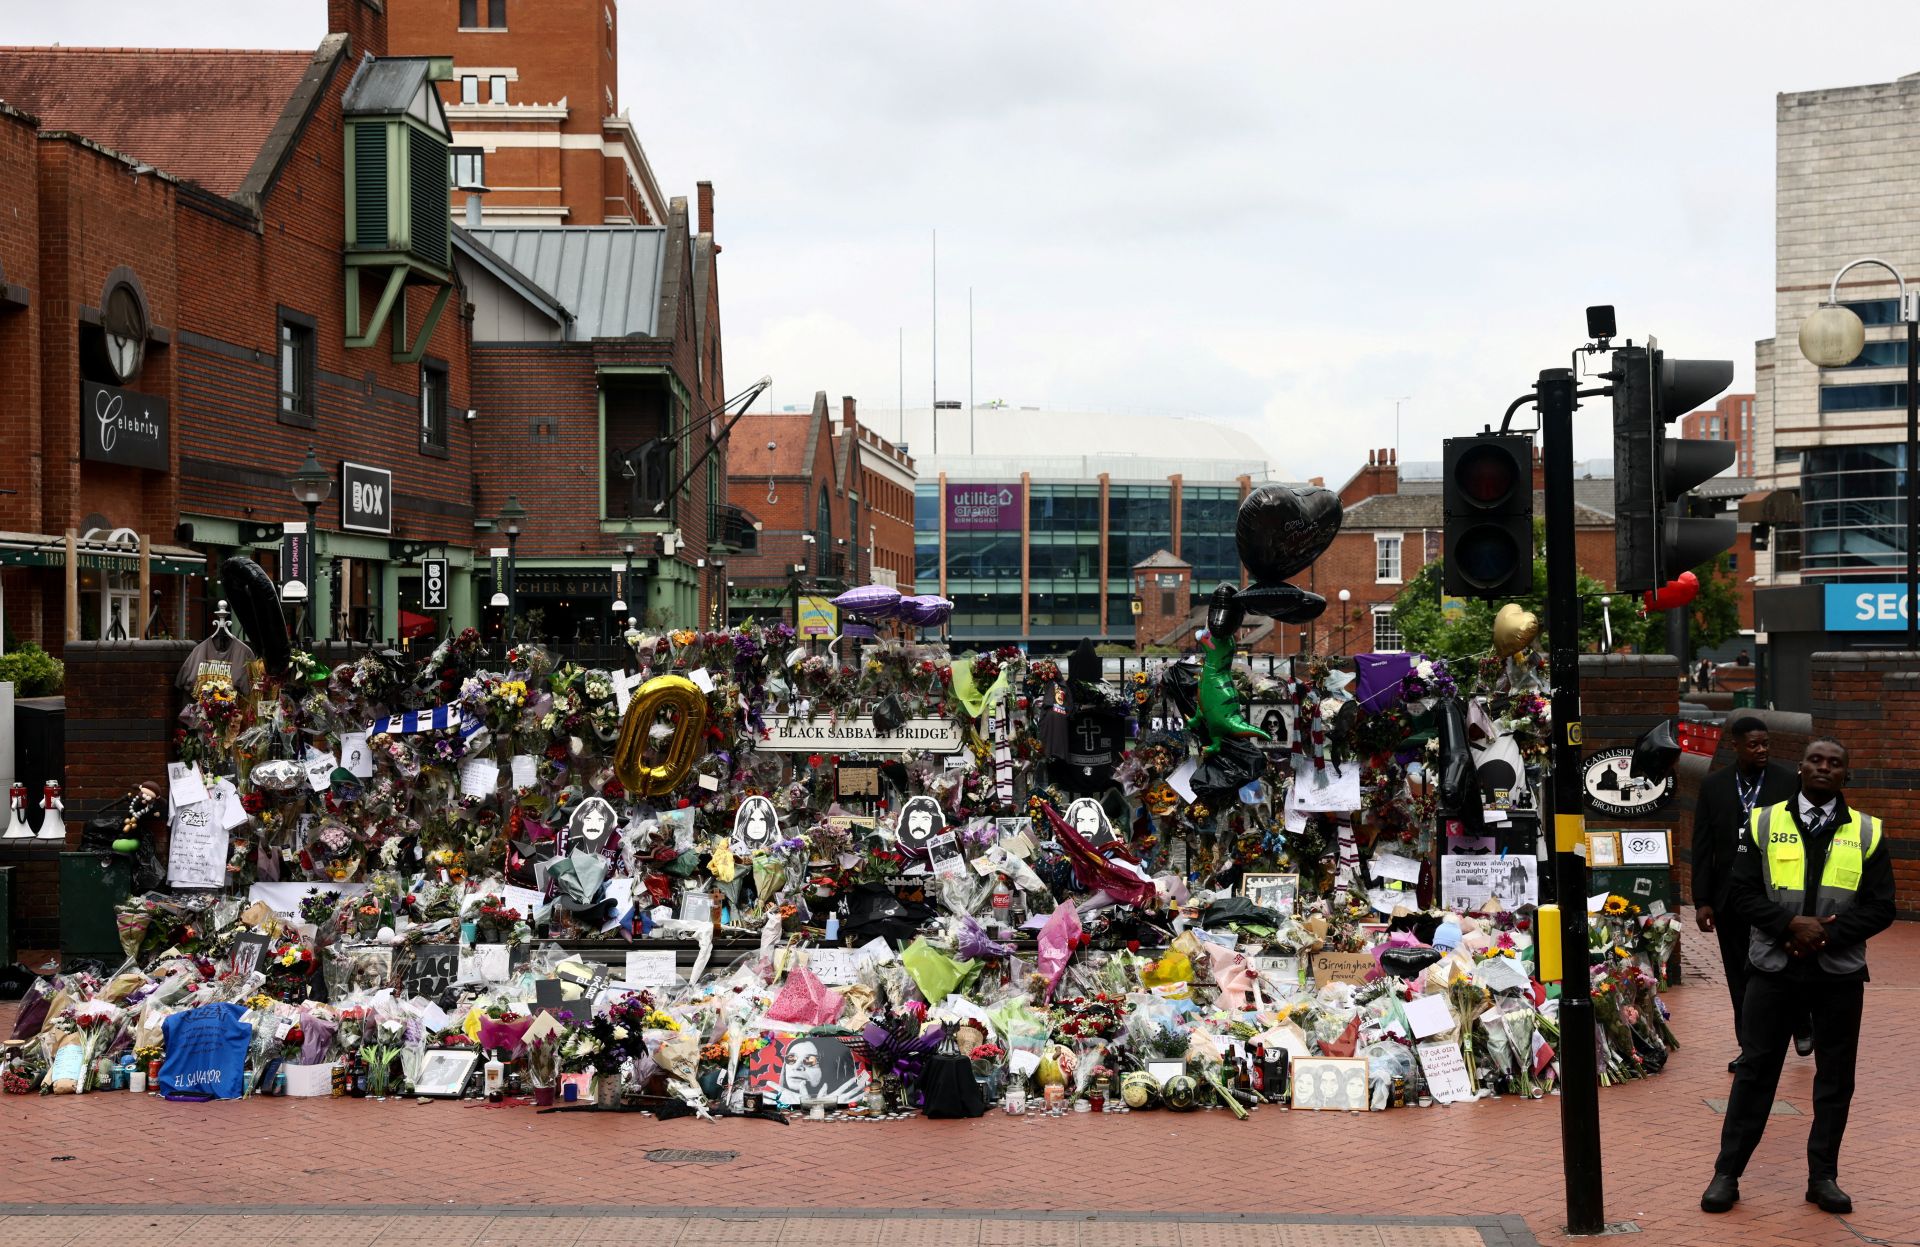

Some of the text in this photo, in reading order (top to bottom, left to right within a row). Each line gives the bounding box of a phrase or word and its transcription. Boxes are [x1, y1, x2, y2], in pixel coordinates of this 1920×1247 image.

[96, 389, 159, 451] Celebrity
[352, 481, 383, 515] BOX
[954, 491, 997, 505] utilita
[45, 552, 140, 571] TRADONAL FREE HOUSE
[428, 564, 442, 604] BOX
[779, 727, 824, 739] BLACK
[896, 728, 949, 740] BRIDGE
[1591, 799, 1658, 814] BROAD STREET
[1771, 832, 1798, 844] 385
[1317, 957, 1376, 973] Birmingham
[1330, 970, 1356, 980] Forever
[174, 1075, 184, 1088] EL
